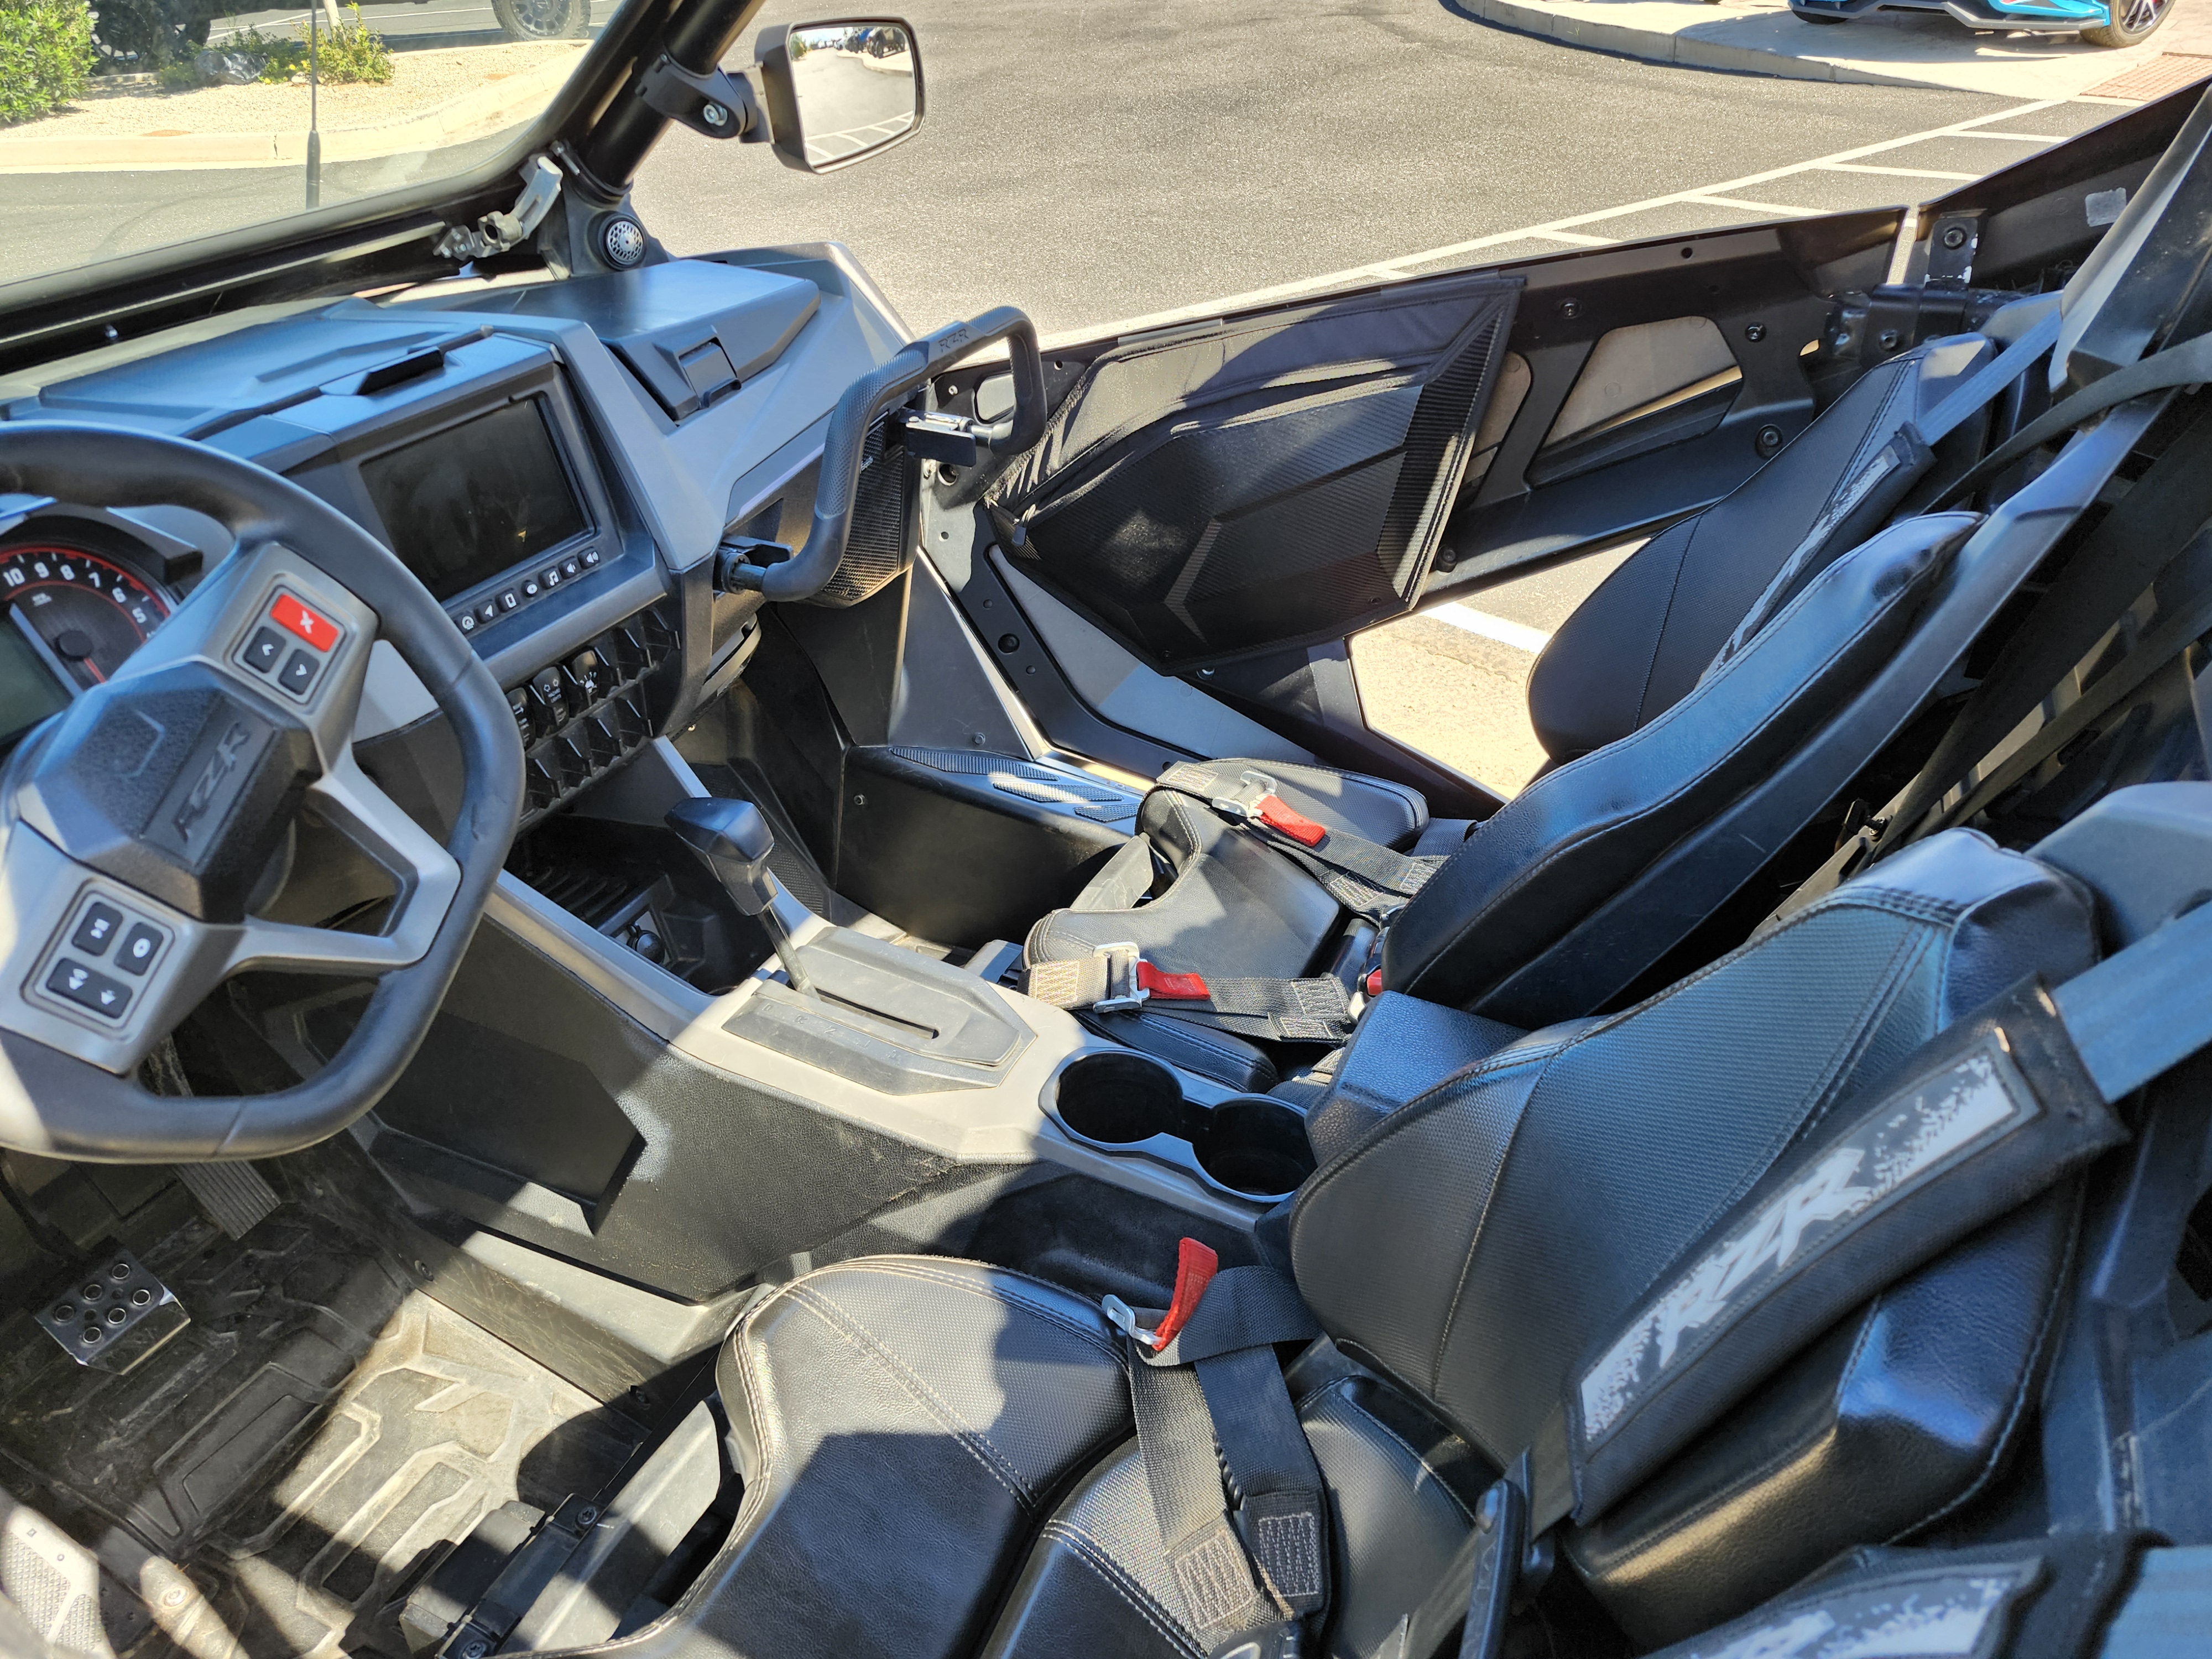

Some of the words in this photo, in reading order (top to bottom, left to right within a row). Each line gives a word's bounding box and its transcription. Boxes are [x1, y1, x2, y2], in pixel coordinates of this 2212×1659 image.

[938, 328, 969, 353] RZR
[3, 567, 25, 587] 10
[34, 561, 50, 578] 9
[60, 564, 75, 581] 8
[88, 572, 101, 588] 7
[112, 587, 127, 603] 6
[132, 607, 147, 623] 5
[172, 721, 251, 844] RZR
[1656, 1147, 1874, 1368] RZR
